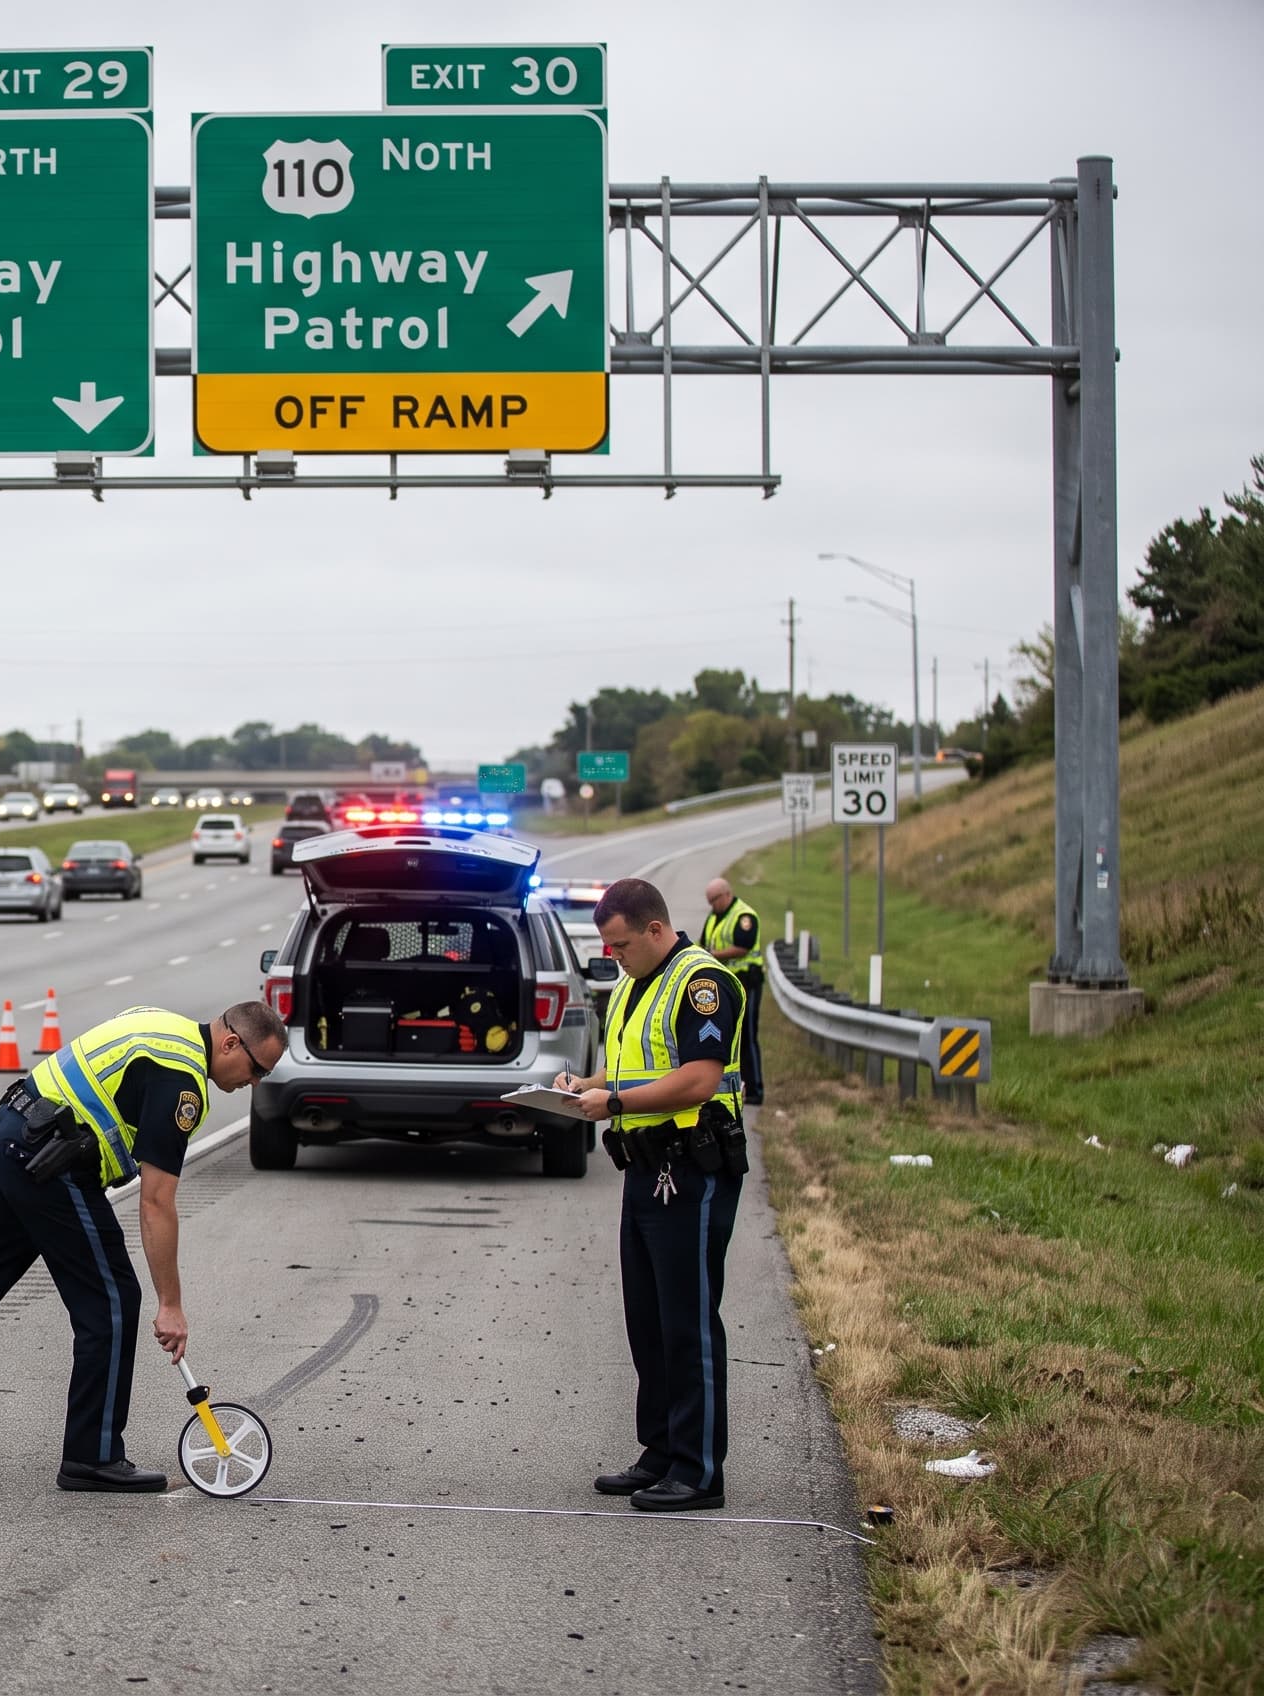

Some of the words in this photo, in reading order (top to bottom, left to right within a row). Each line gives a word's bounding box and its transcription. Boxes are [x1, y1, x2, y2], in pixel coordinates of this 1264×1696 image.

[63, 61, 128, 100] 29
[411, 64, 486, 90] EXIT
[510, 57, 578, 96] 30
[382, 138, 492, 171] NOTH
[272, 158, 344, 198] 110
[226, 240, 488, 298] Highway
[264, 306, 448, 350] Patrol
[274, 396, 366, 429] OFF
[392, 395, 528, 428] RAMP
[837, 752, 892, 767] SPEED
[843, 771, 885, 783] LIMIT
[842, 789, 887, 816] 30
